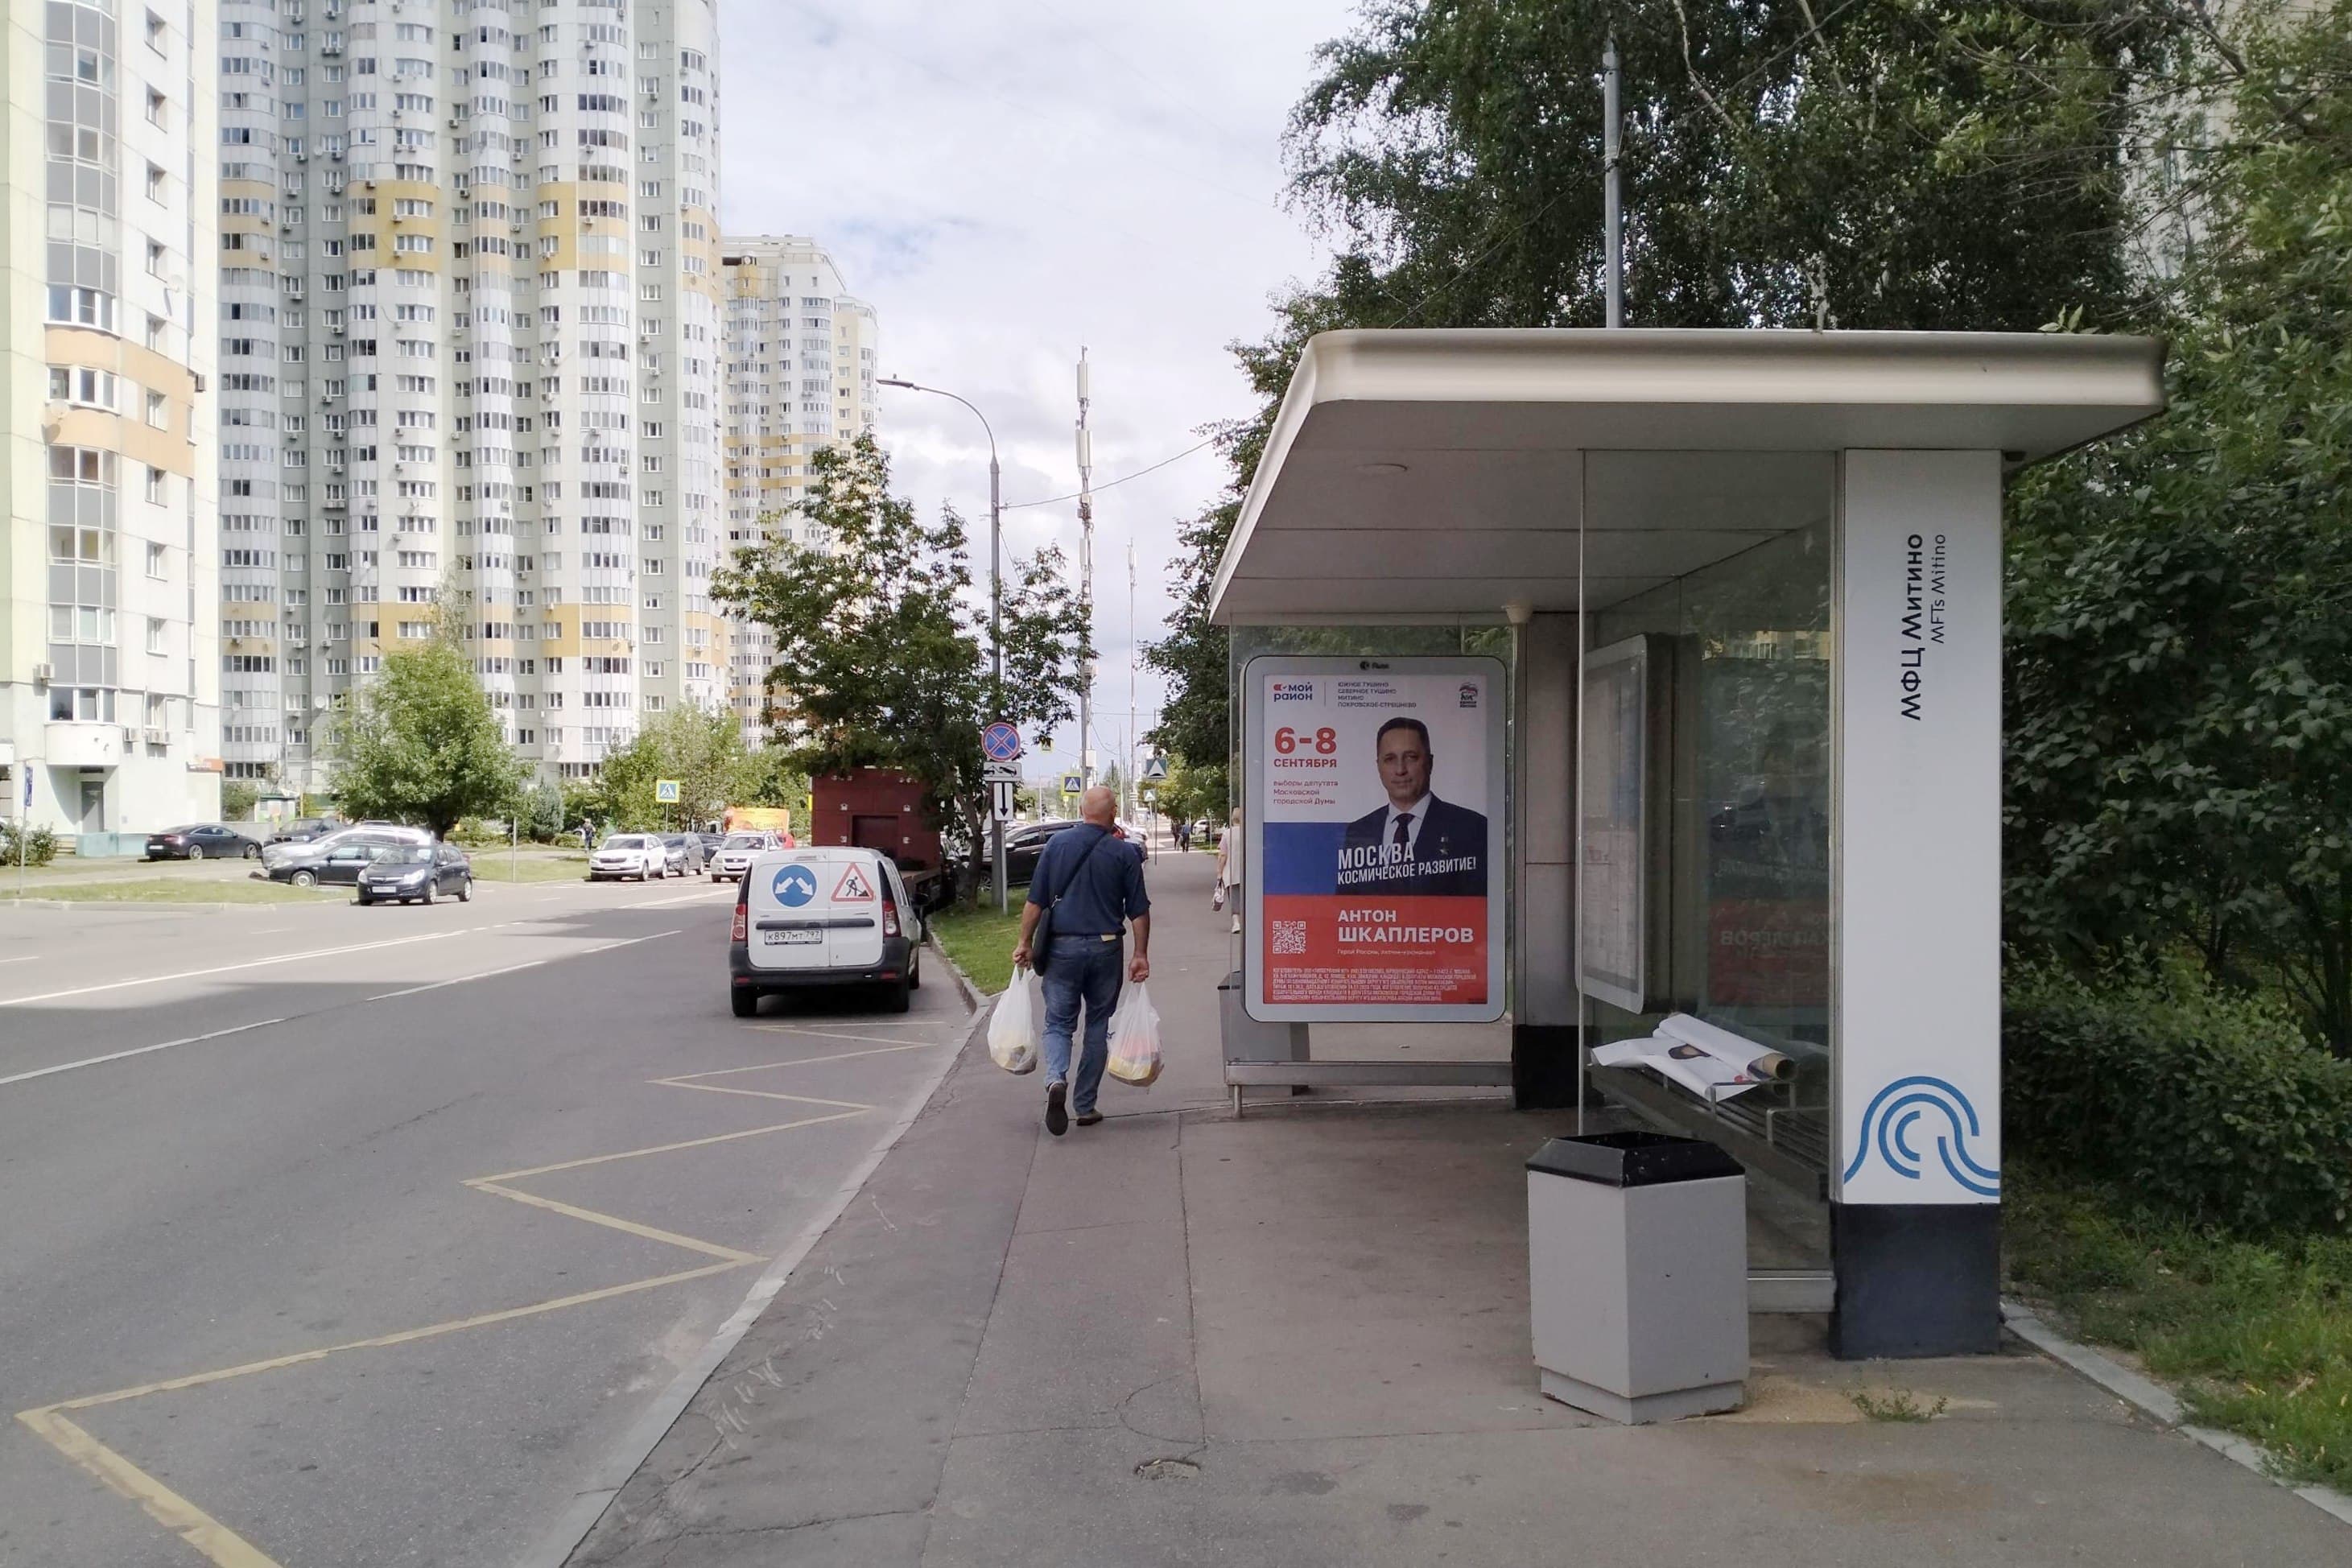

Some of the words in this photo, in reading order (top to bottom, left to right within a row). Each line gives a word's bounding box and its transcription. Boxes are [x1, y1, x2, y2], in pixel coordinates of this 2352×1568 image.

[1932, 534, 1946, 595] Mitino
[1901, 534, 1923, 641] Митино
[1288, 682, 1313, 692] мой
[1900, 647, 1925, 720] МФЦ
[1273, 758, 1337, 768] СЕНТЯБРЯ
[1338, 842, 1415, 870] МОСКВА
[1337, 863, 1416, 885] КОСМИЧЕСКОЕ
[1418, 856, 1476, 876] РАЗВИТИЕ!
[1338, 910, 1397, 922] АНТОН
[1338, 926, 1475, 943] ШКАПЛЕРОВ
